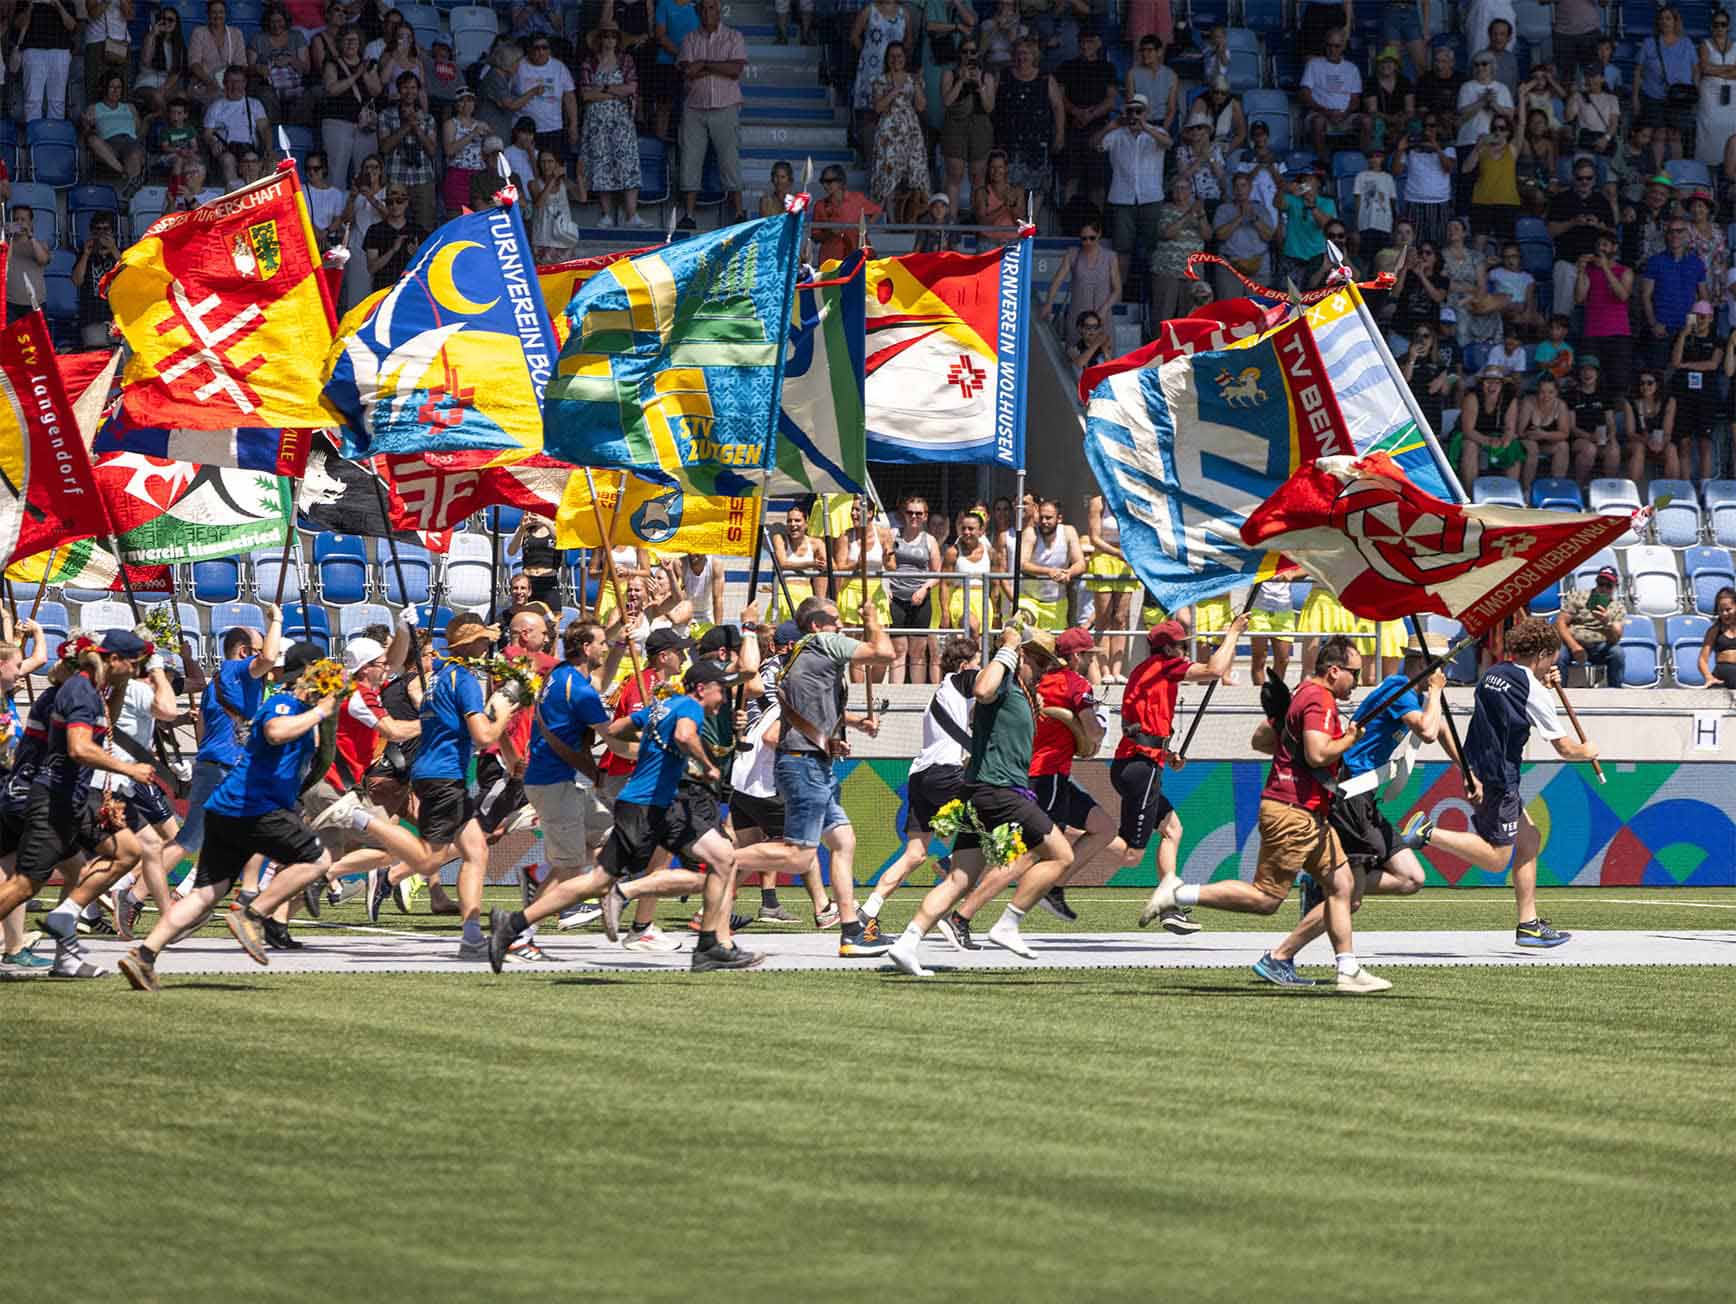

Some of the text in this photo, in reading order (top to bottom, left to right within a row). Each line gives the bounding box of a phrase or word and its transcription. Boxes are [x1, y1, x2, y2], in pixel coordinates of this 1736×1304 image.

[488, 209, 545, 349] TURNVEREIN
[997, 243, 1021, 463] TURNVEREIN WOLHUSEN
[1283, 332, 1313, 377] TV
[31, 375, 84, 495] langendorf
[680, 417, 714, 439] STV
[1476, 570, 1542, 619] ROGGWIL
[1697, 719, 1717, 745] H
